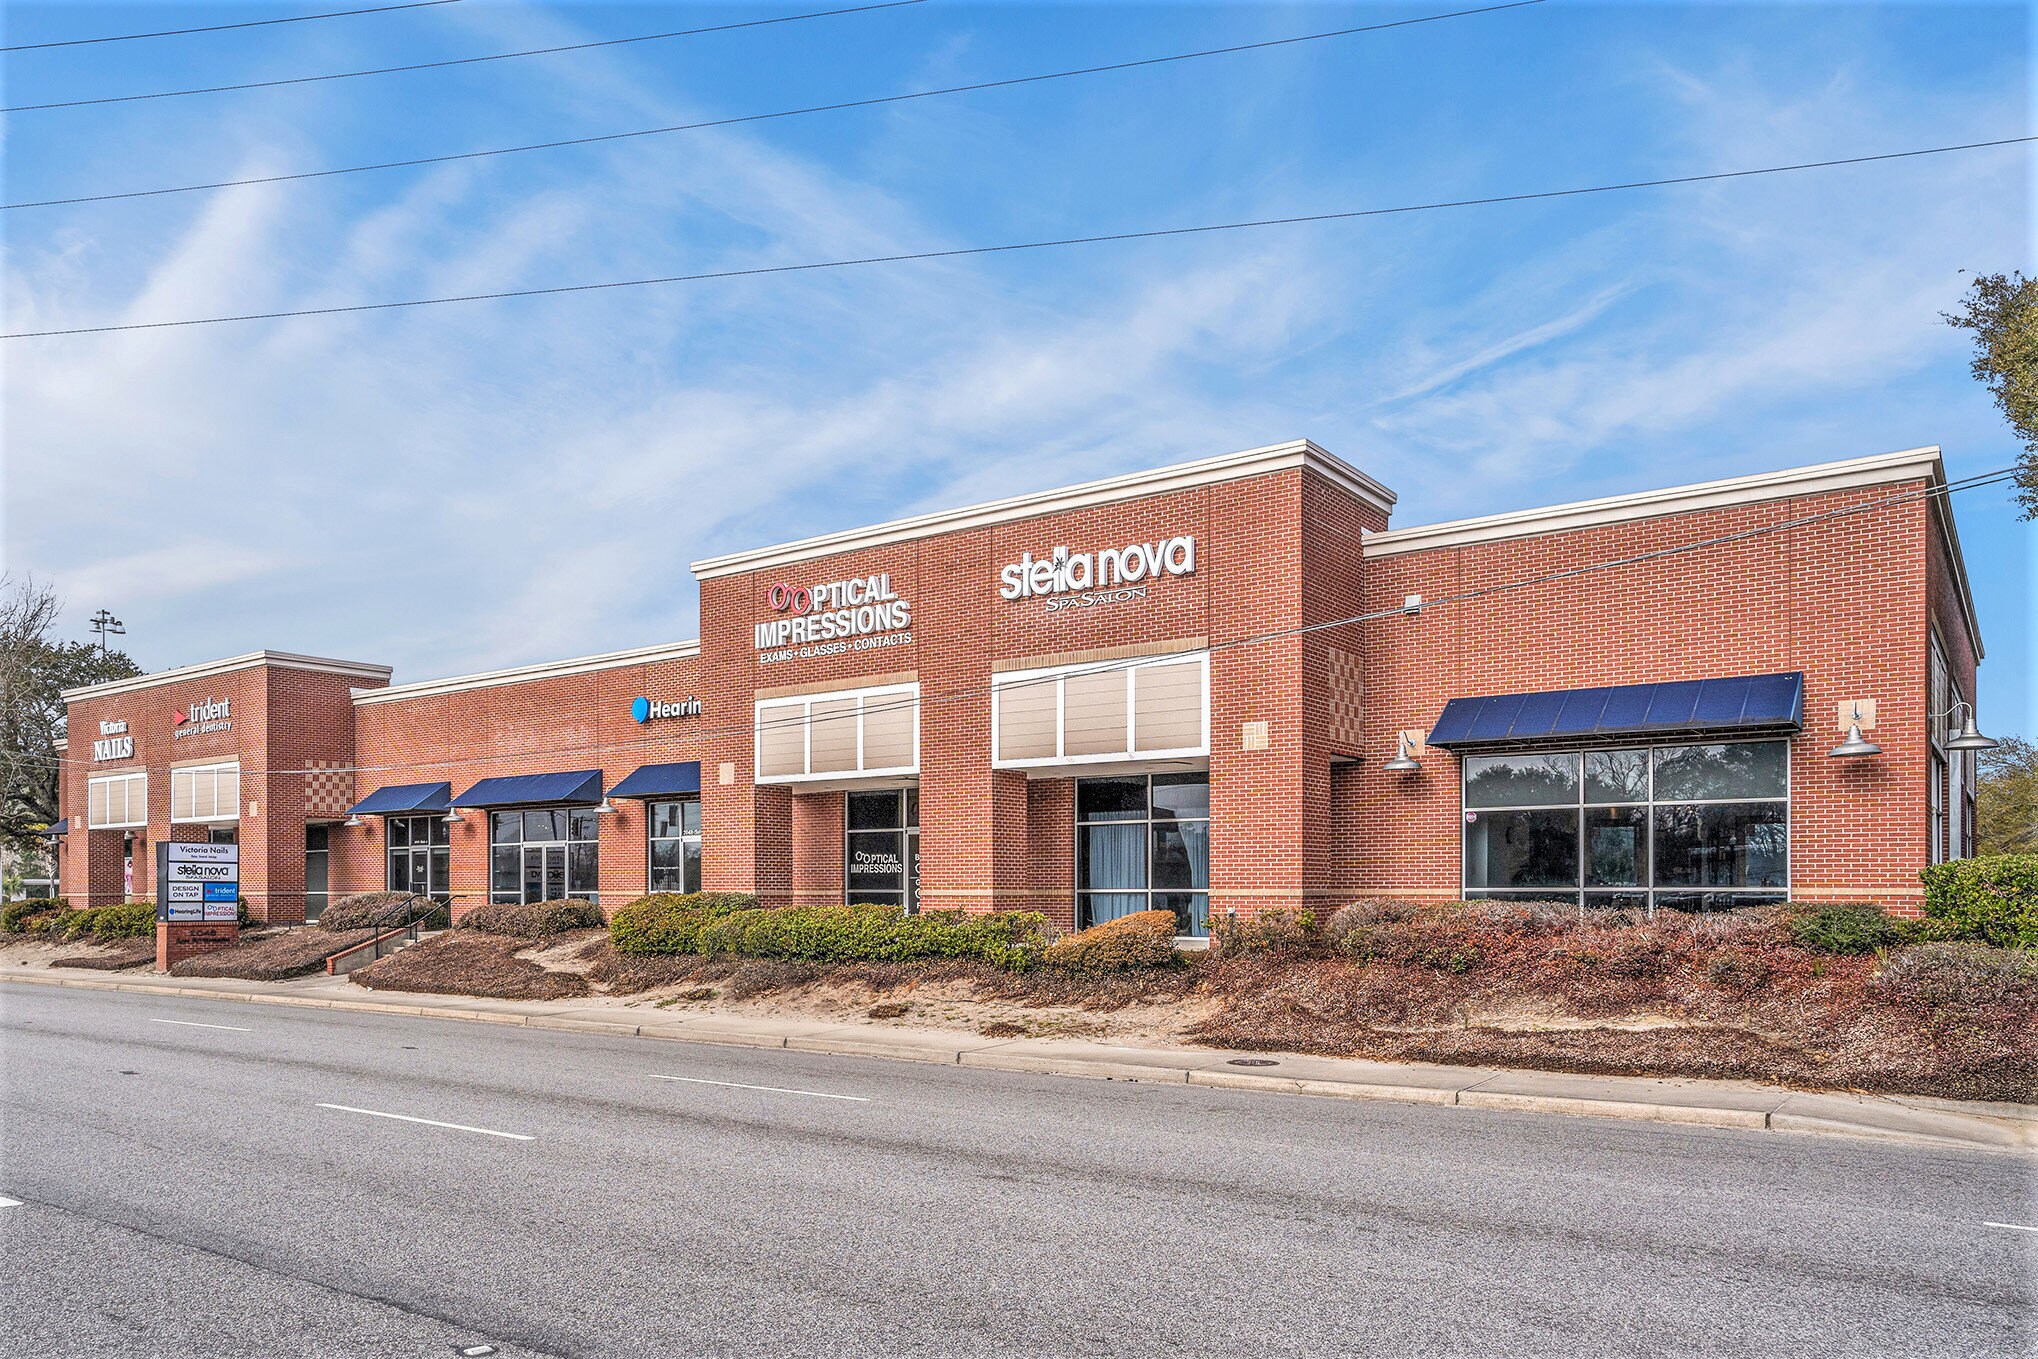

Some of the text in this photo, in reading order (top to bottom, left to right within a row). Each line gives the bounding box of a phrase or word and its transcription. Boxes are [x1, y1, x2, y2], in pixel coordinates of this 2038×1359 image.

[1000, 535, 1195, 600] stella nova
[754, 600, 912, 650] IMPRESSIONS
[760, 632, 912, 664] EXAMS GLASSES CONTACTS
[190, 697, 231, 722] trident
[650, 695, 702, 719] Hearin
[100, 719, 128, 736] Victoria
[174, 721, 232, 740] general dentistry
[94, 736, 134, 761] NAILS
[177, 864, 229, 876] stella nova
[850, 864, 903, 873] IMPRESSIONS
